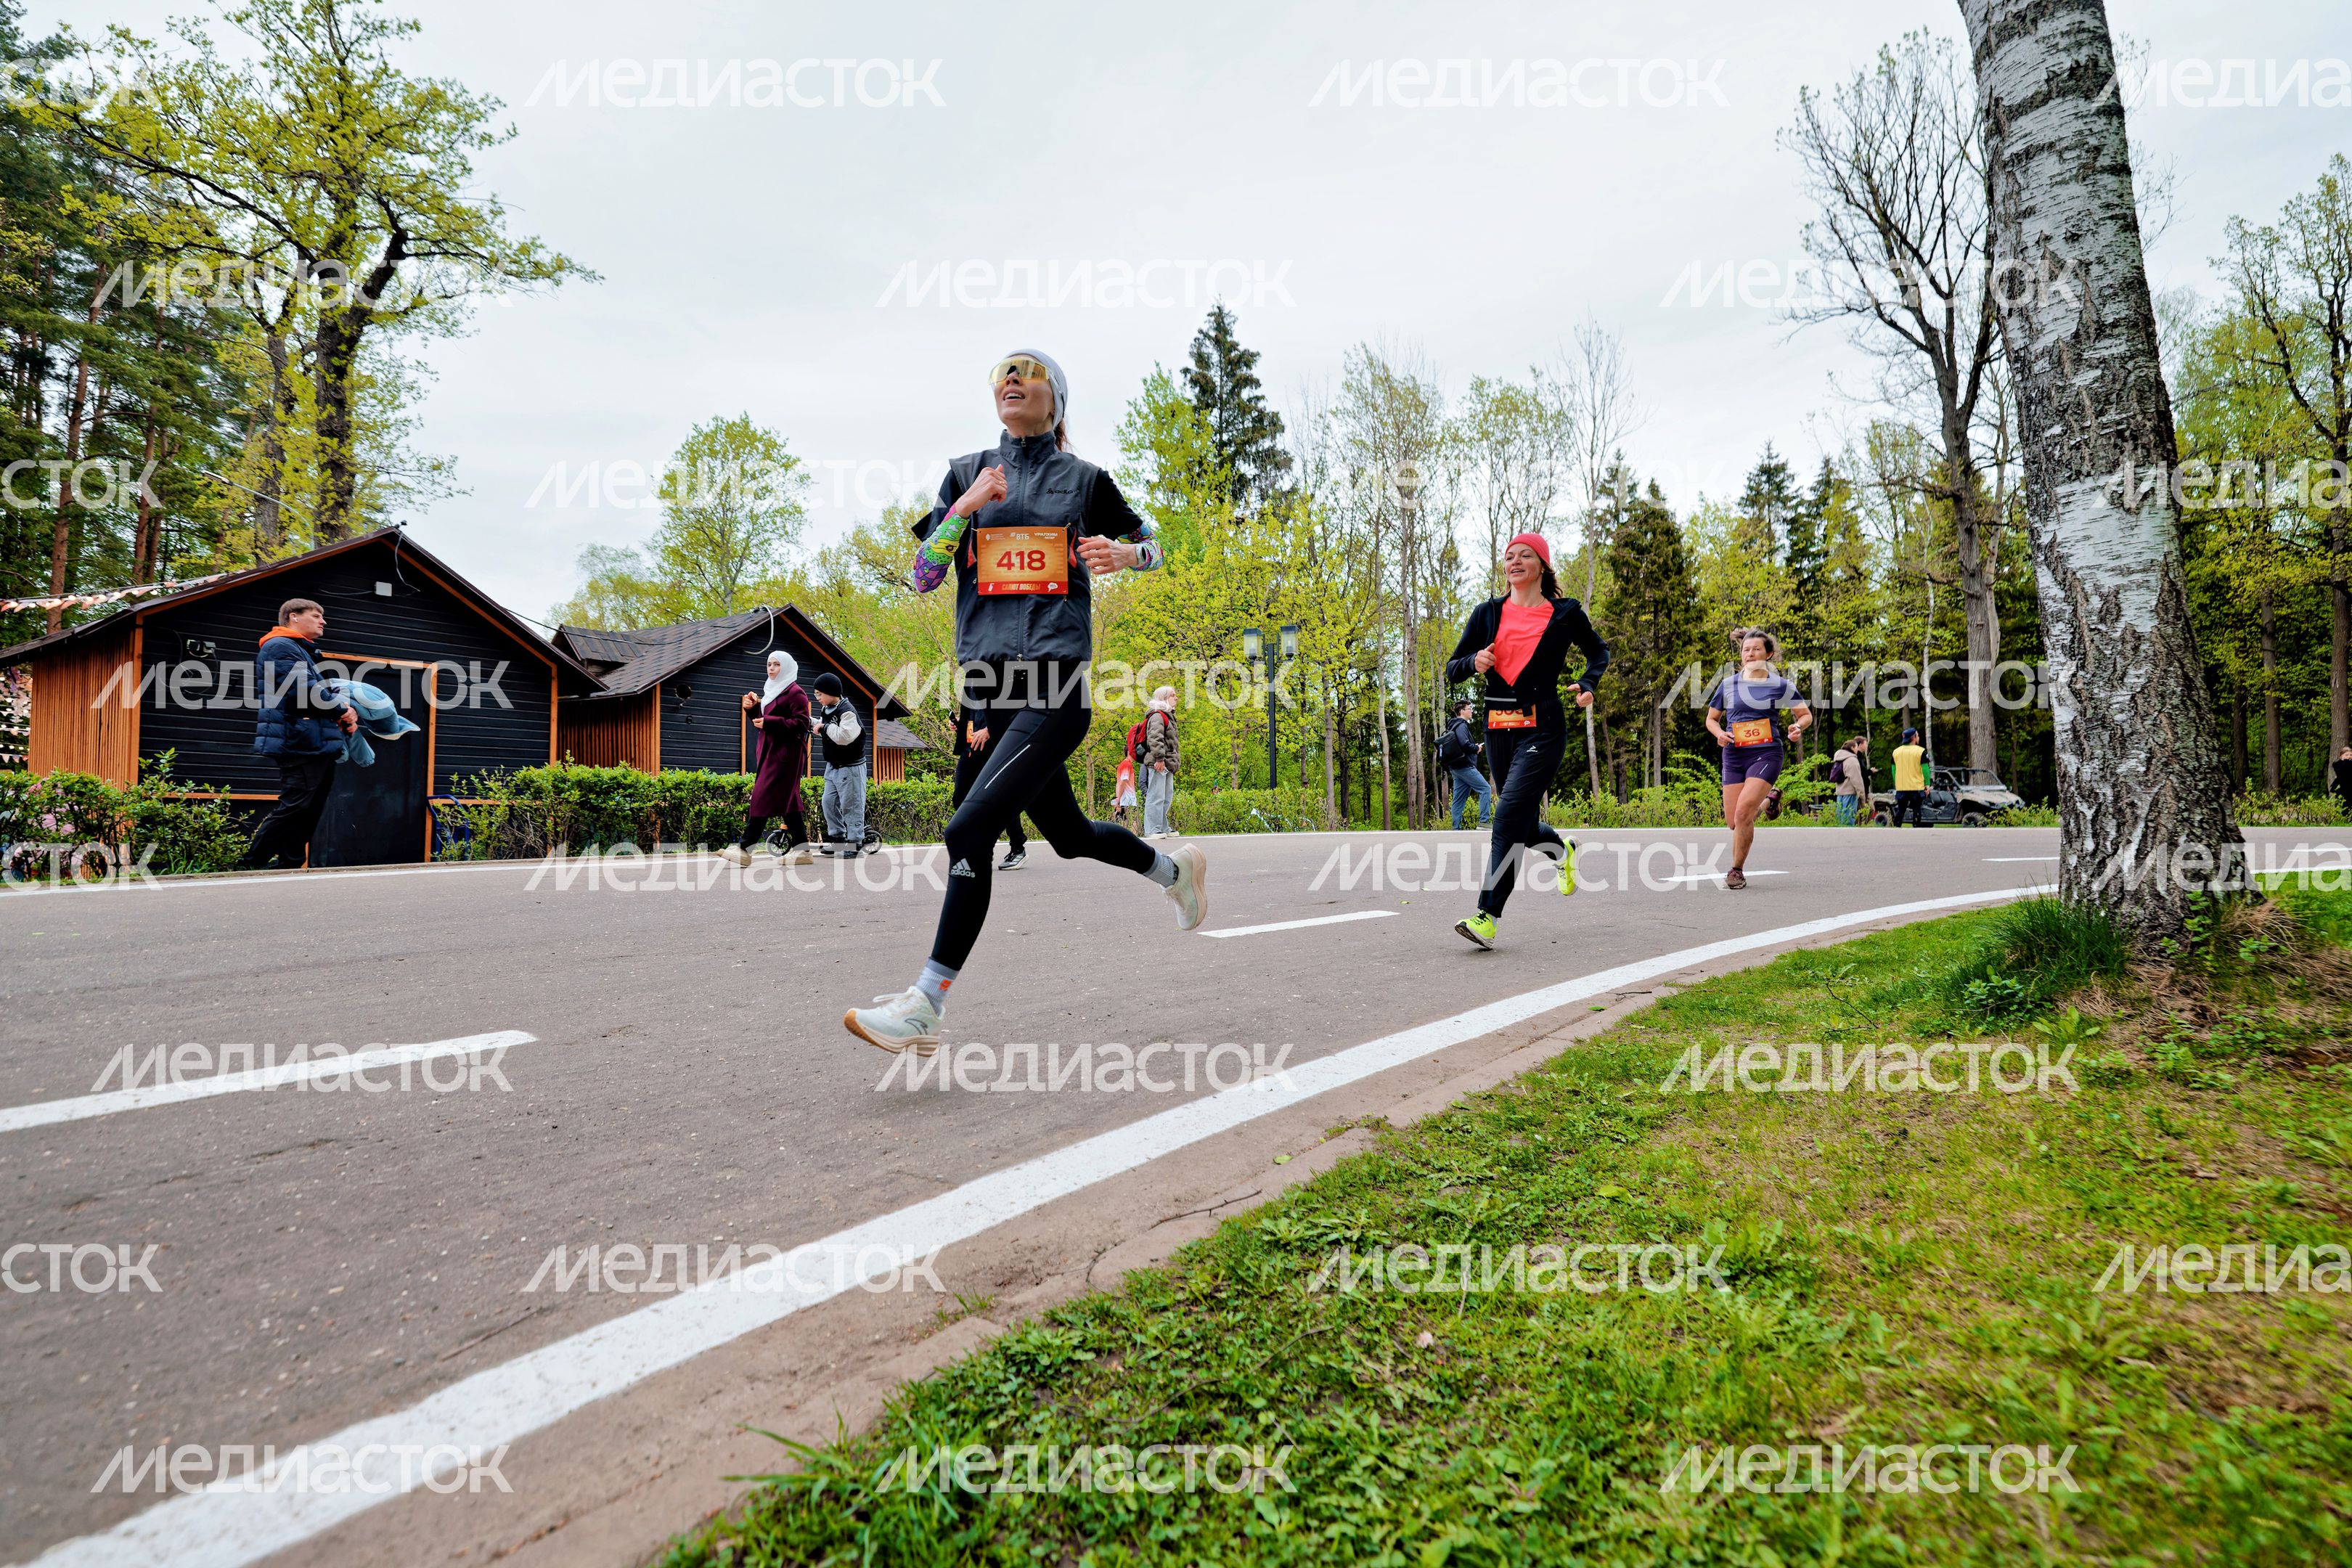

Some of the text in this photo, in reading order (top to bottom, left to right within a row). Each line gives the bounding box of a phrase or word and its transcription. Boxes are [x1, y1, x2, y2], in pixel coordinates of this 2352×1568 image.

[996, 550, 1046, 571] 418
[1744, 728, 1760, 738] 36
[951, 869, 975, 878] adidas
